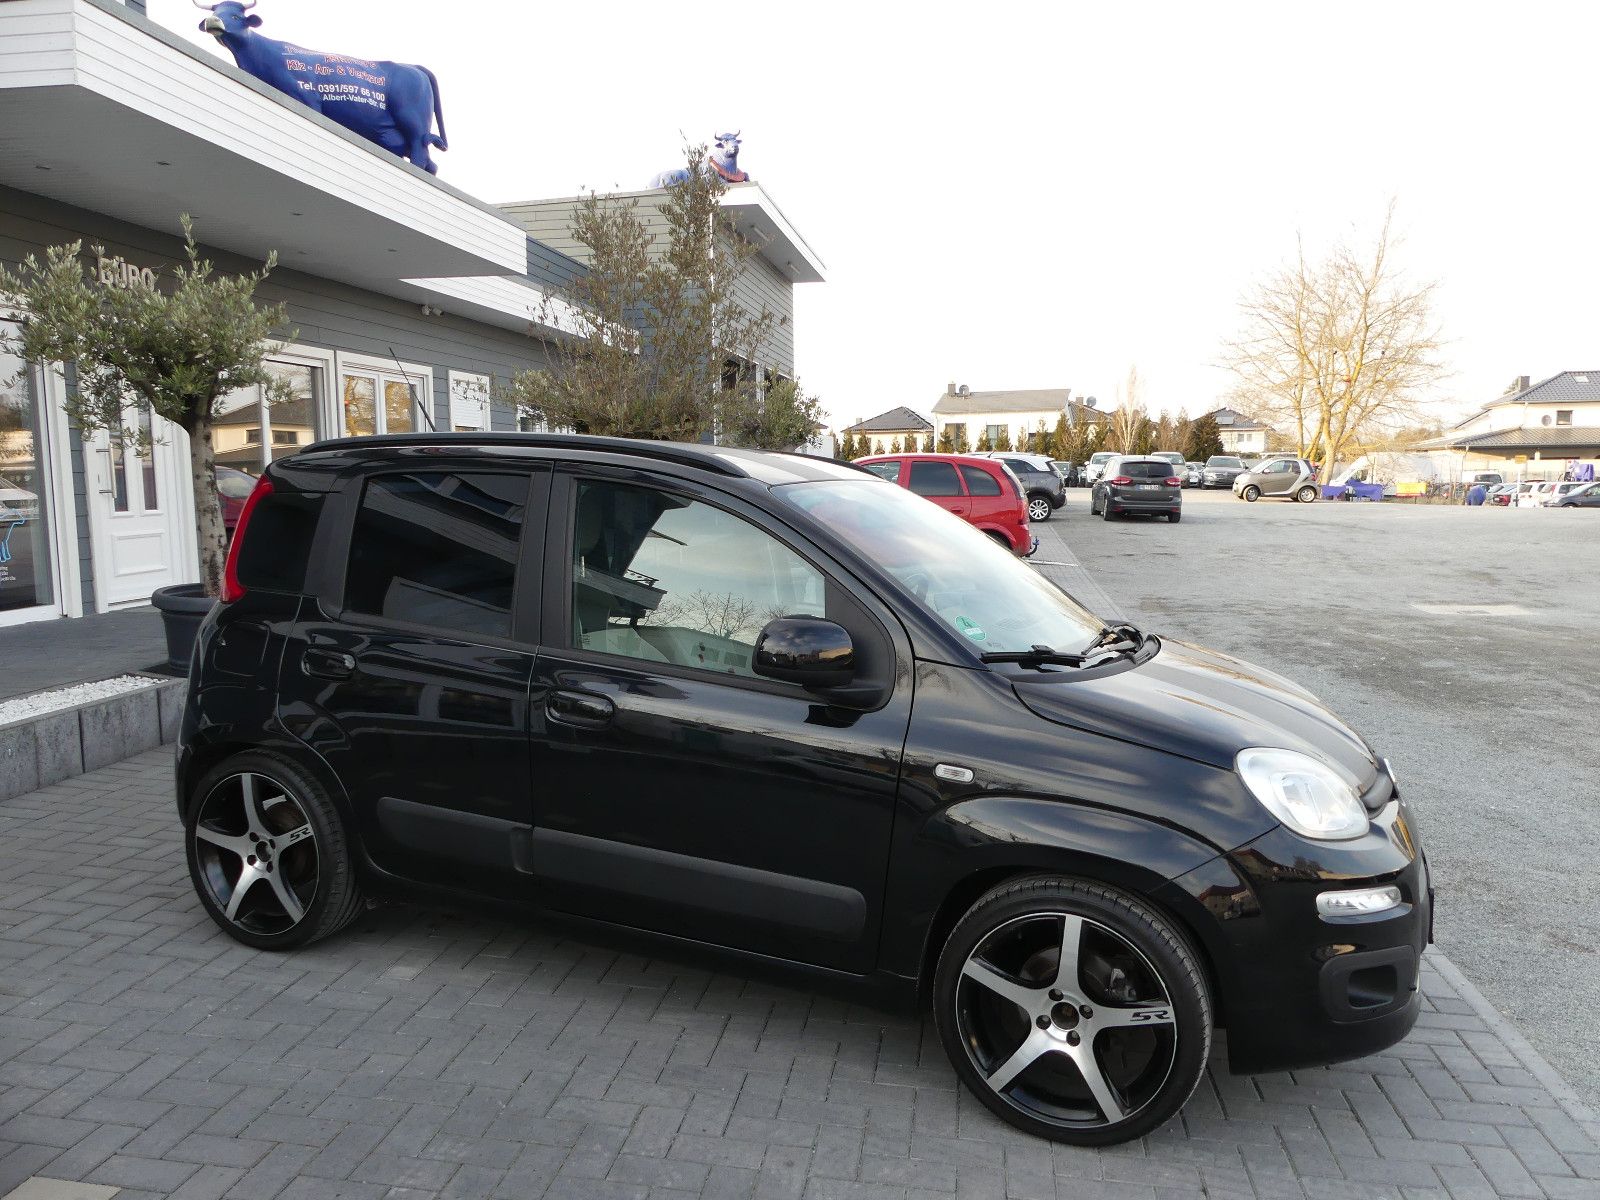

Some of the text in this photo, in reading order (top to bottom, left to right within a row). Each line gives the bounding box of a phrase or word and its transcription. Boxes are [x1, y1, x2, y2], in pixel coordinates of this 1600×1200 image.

[297, 80, 316, 91] Tel.
[318, 84, 359, 94] 0391/597
[372, 91, 386, 102] 100
